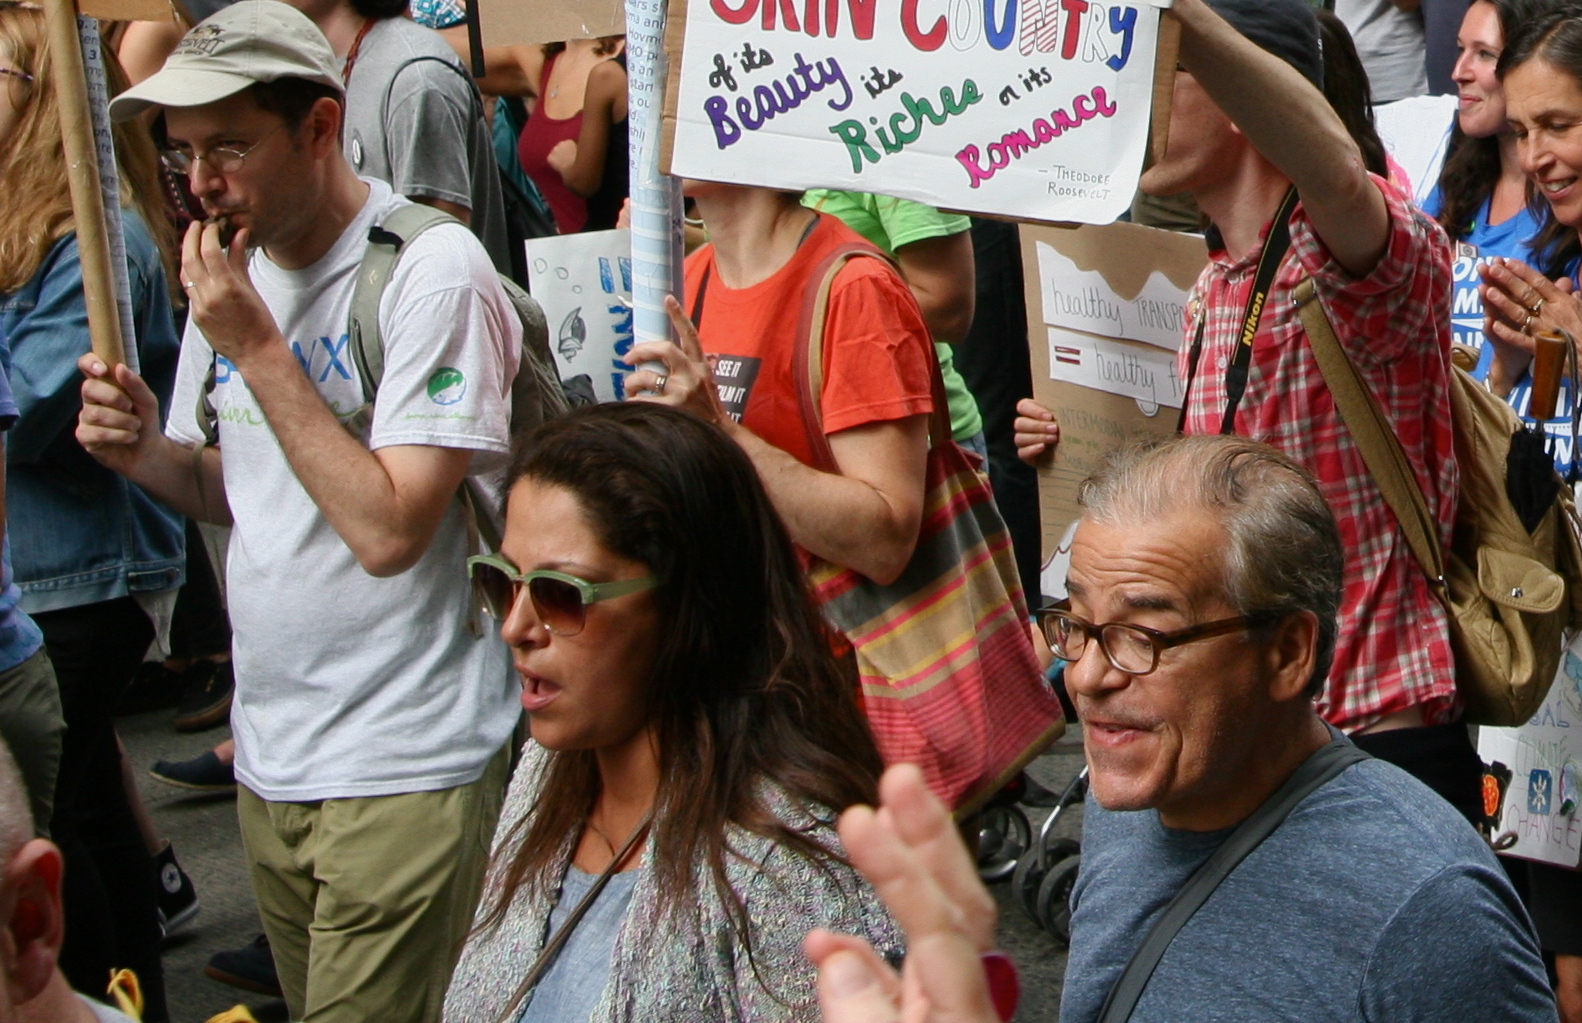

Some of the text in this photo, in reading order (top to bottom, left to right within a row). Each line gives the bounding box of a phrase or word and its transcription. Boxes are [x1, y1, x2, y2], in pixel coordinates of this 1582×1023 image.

[709, 53, 738, 92] of
[733, 42, 774, 73] its
[1017, 66, 1052, 93] its
[703, 52, 853, 151] Beauty
[860, 65, 904, 99] its
[955, 85, 1117, 189] Romance
[1051, 278, 1125, 336] healthy
[1242, 291, 1265, 347] Nikon
[716, 359, 734, 377] SEE
[1094, 343, 1156, 401] healthy
[1507, 803, 1581, 851] CHANGE
